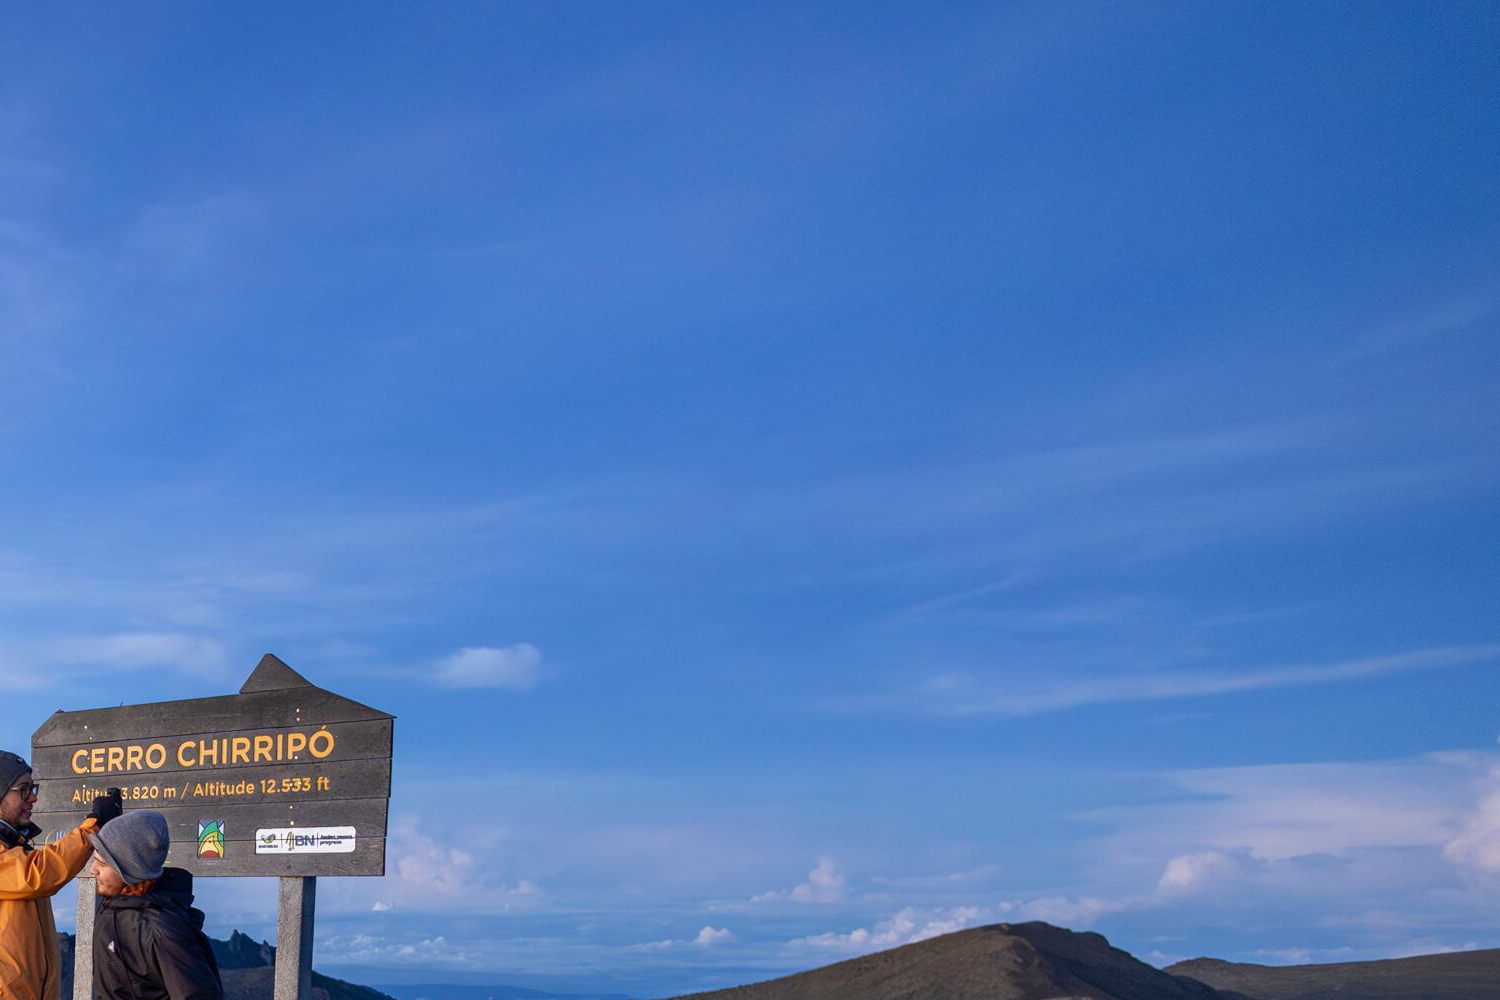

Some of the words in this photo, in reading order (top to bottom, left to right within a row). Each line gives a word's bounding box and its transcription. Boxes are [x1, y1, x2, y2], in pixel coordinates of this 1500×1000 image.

[71, 743, 167, 775] CERRO
[177, 725, 335, 768] CHIRRIPÓ
[72, 786, 113, 803] Altitu
[121, 785, 159, 801] 3.820
[163, 786, 177, 799] m
[180, 782, 190, 800] /
[193, 779, 255, 798] Altitude
[260, 776, 312, 794] 12.533
[316, 775, 331, 791] ft
[294, 834, 315, 847] BN
